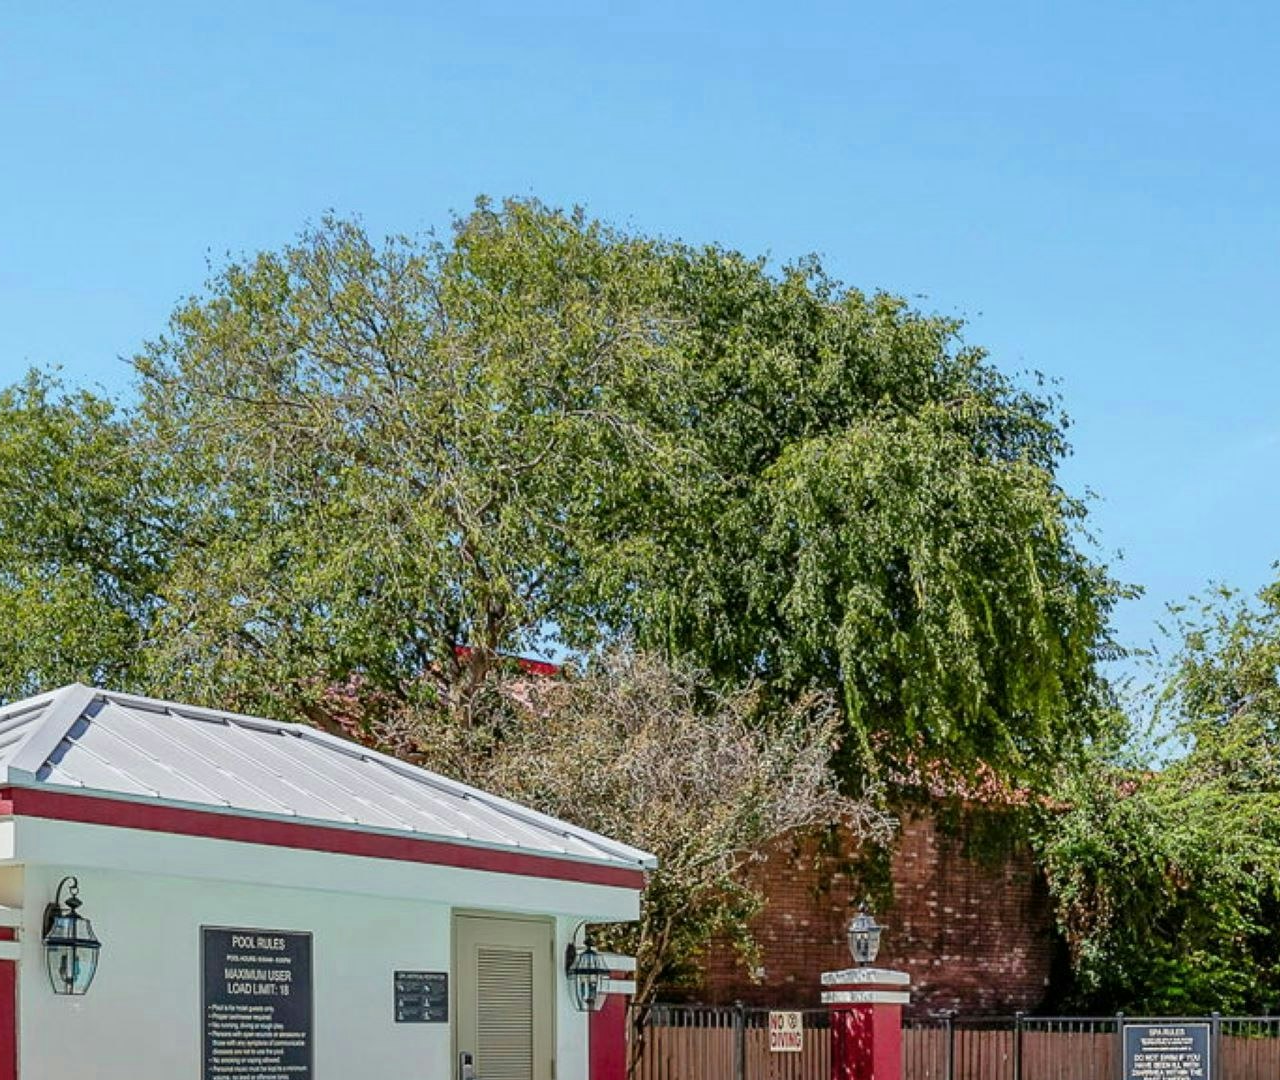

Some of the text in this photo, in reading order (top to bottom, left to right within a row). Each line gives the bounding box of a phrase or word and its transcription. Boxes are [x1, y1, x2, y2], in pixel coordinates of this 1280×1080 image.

[232, 935, 285, 950] POOL RULES
[225, 968, 291, 982] MAXIMUM USER
[227, 982, 252, 994] LOAD
[253, 983, 278, 995] LIMIT:
[771, 1013, 784, 1030] NO
[771, 1031, 801, 1048] DIVING
